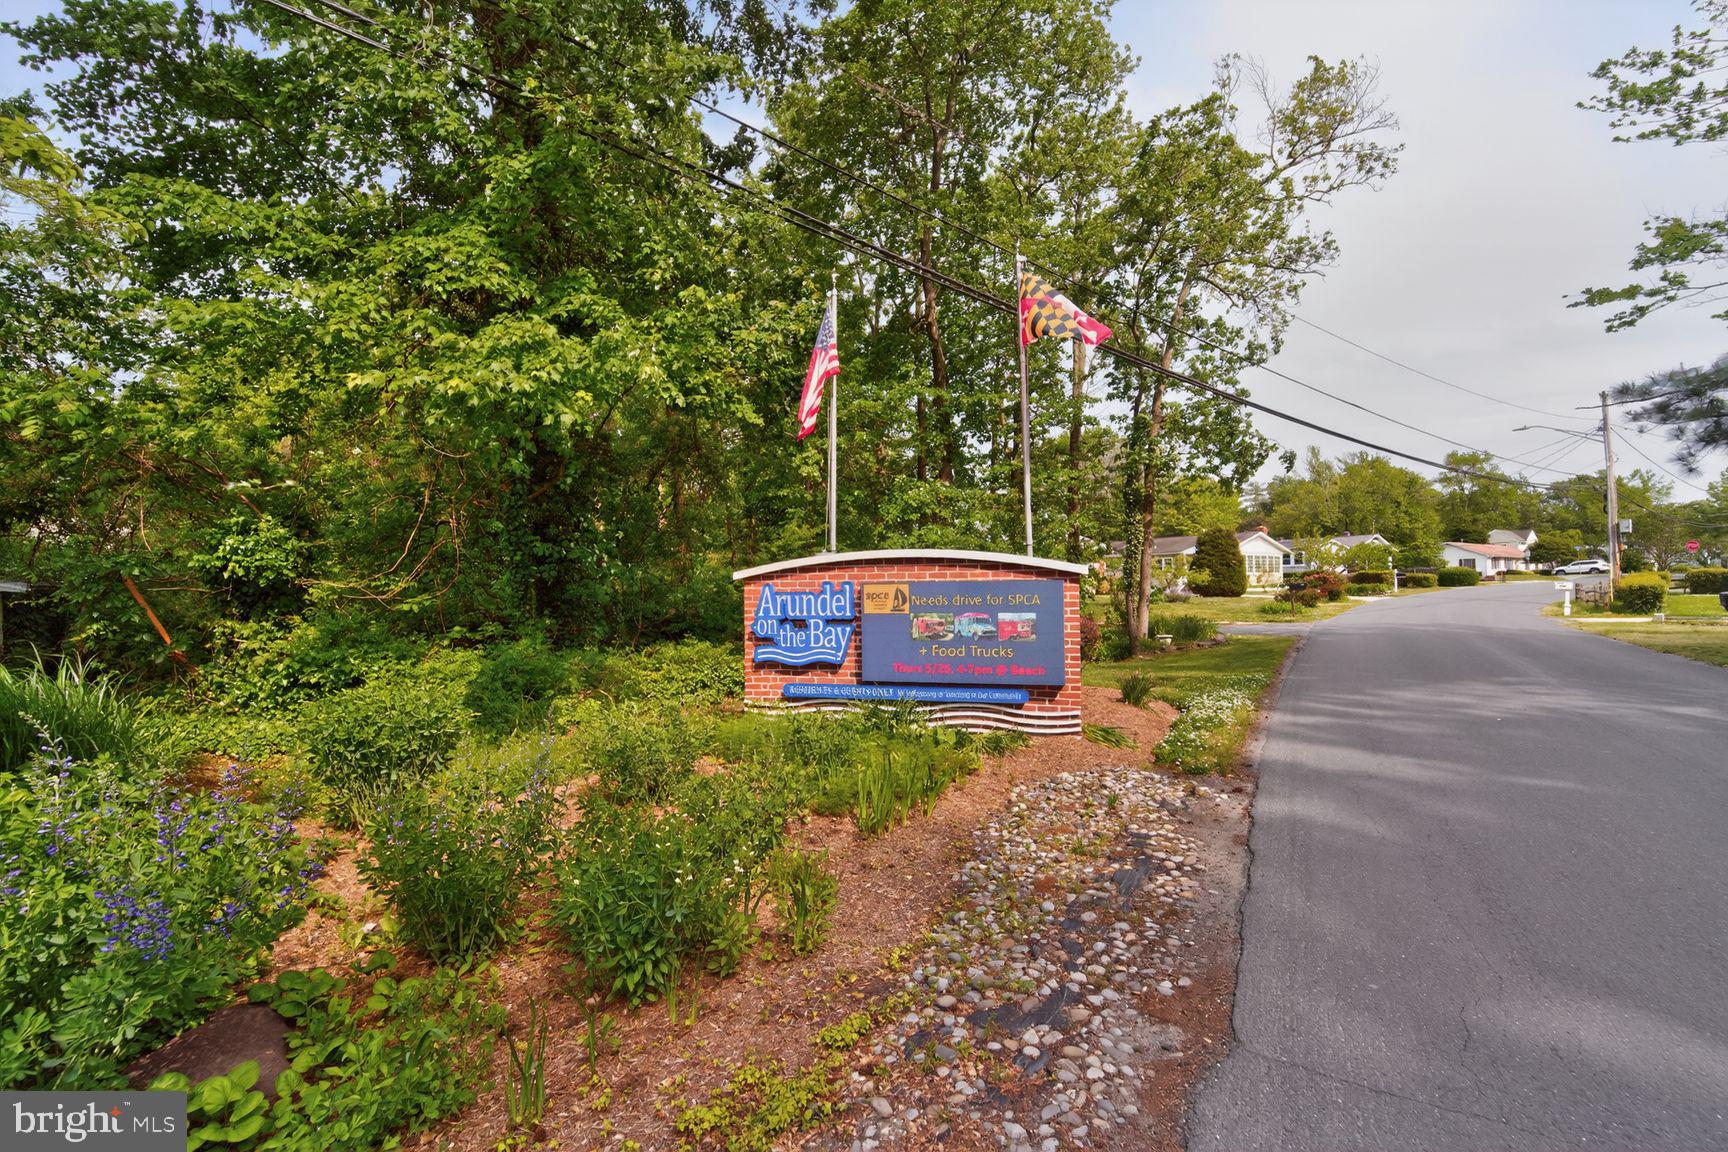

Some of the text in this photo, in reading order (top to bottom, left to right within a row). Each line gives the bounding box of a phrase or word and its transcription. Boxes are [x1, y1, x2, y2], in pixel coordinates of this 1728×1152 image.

[758, 584, 852, 616] Arundel
[911, 594, 1041, 606] Needs drive for SPCA
[757, 619, 851, 661] on the Bay
[932, 645, 966, 657] Food
[970, 645, 1014, 658] Trucks
